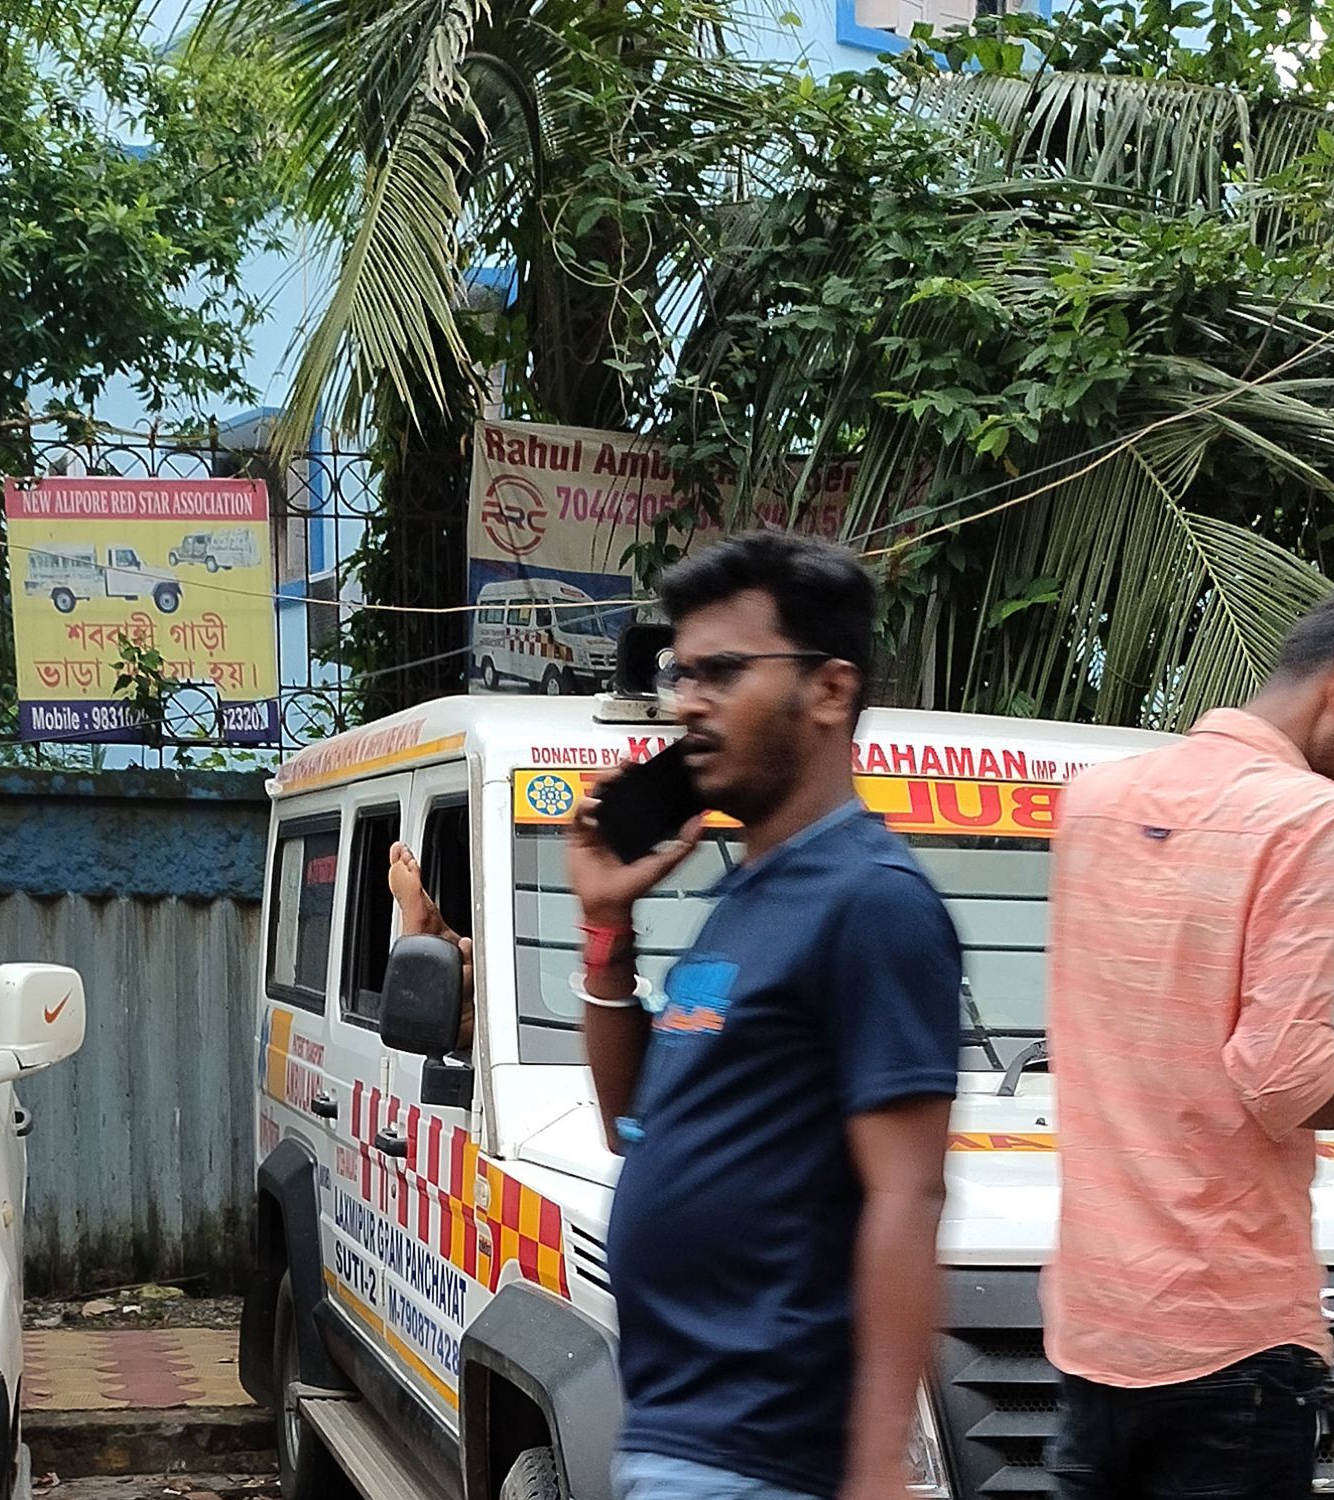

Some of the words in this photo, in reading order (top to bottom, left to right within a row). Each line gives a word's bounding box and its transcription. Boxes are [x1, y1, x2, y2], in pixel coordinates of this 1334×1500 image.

[483, 427, 583, 473] Rahul
[22, 491, 53, 513] NEW
[55, 490, 109, 514] ALIPORE
[111, 491, 136, 514] RED
[138, 491, 170, 514] STAR
[172, 492, 254, 515] ASSOCIATION
[481, 500, 548, 534] RRC
[170, 612, 228, 657] গাড়ী
[33, 657, 103, 694] ভাড়া
[31, 706, 80, 731] Mobile
[531, 746, 598, 766] DONATED
[334, 1185, 376, 1253] LAXMIPUR
[377, 1217, 404, 1279] GRAM
[405, 1237, 467, 1330] PANCHAYAT
[335, 1239, 378, 1307] SUTI-2
[388, 1284, 461, 1377] M-790877428
